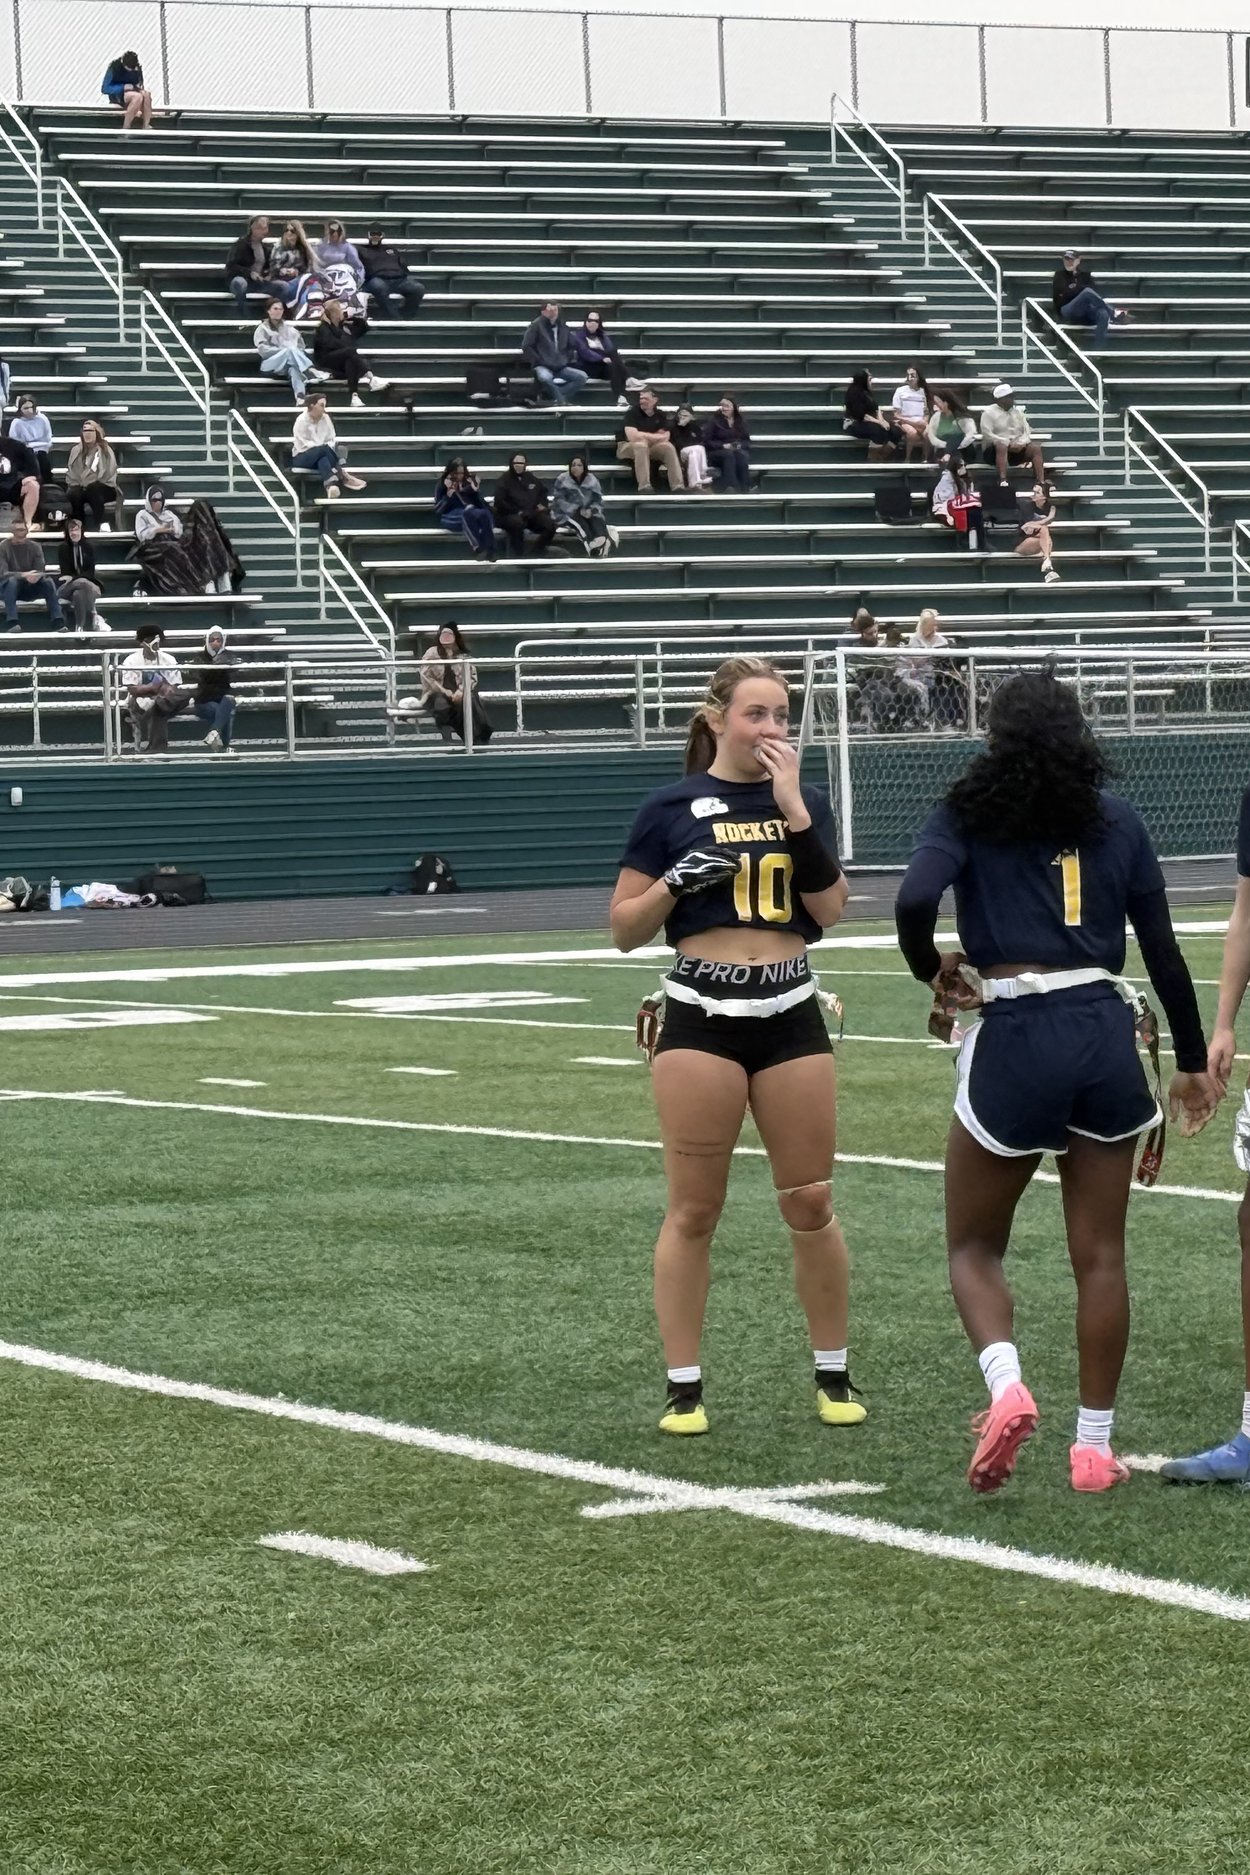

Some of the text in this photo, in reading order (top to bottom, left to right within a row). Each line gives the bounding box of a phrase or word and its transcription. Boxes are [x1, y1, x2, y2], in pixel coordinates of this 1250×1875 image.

[734, 852, 794, 923] 10
[1050, 848, 1082, 926] 1
[693, 960, 751, 984] PRO
[760, 954, 807, 985] NIKE
